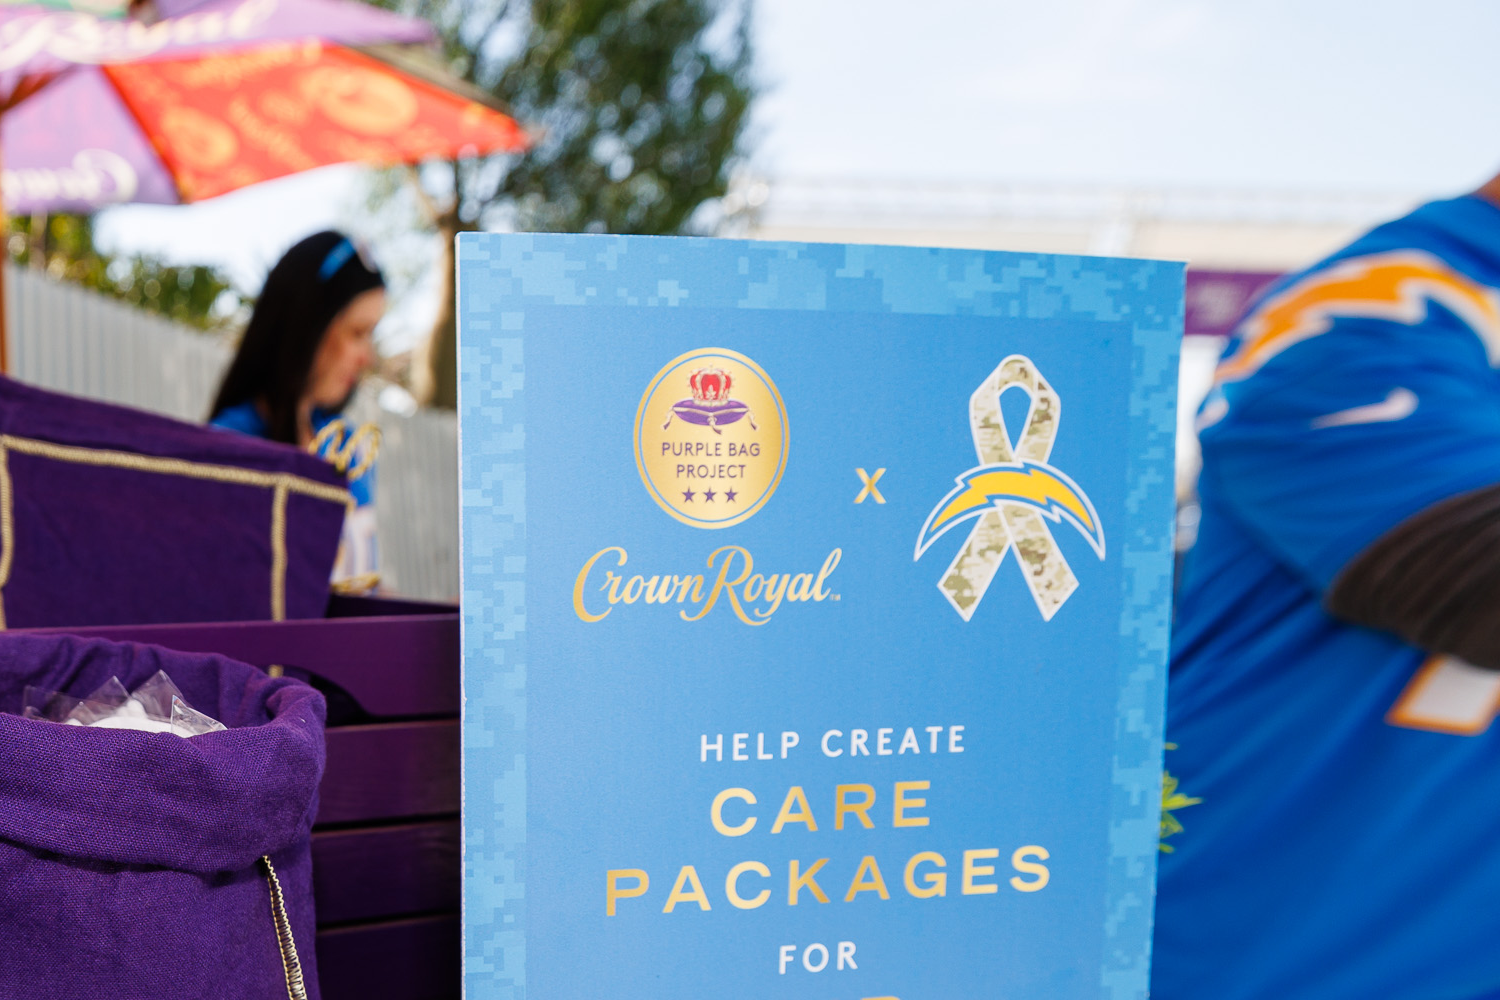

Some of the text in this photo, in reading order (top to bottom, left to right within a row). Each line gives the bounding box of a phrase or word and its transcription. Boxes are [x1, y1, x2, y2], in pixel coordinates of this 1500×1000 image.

[661, 441, 760, 456] PURPLE BAG
[676, 464, 746, 478] PROJECT
[573, 546, 706, 623] Crown
[679, 545, 842, 626] Royal
[700, 725, 966, 763] HELP CREATE
[710, 780, 931, 837] CARE
[606, 846, 1051, 916] PACKAGES
[779, 941, 858, 975] FOR
